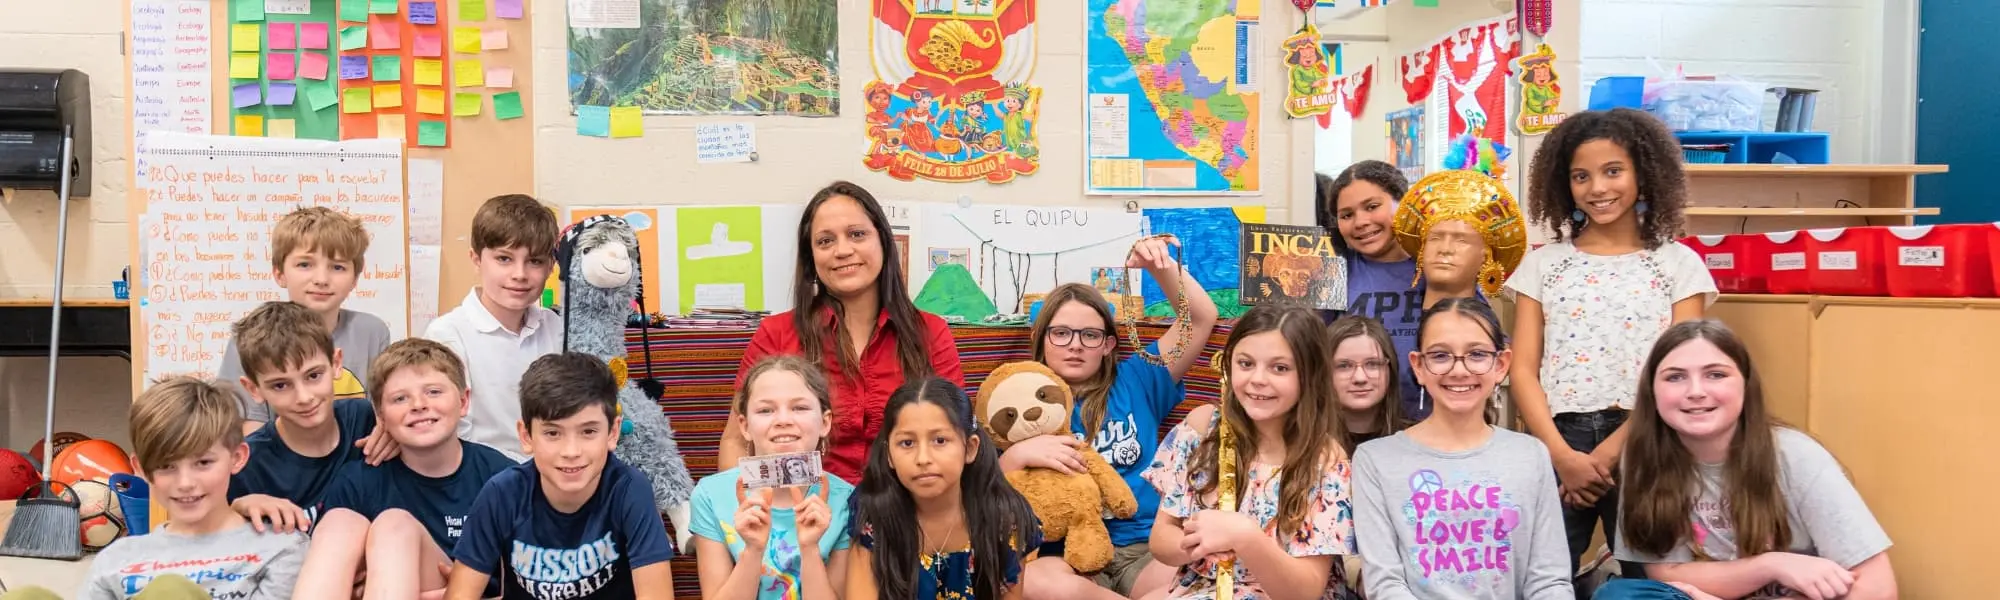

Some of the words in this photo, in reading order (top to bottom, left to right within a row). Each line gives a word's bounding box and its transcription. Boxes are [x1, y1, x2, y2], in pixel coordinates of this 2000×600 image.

[1294, 97, 1309, 109] TE
[1311, 92, 1336, 107] AMO
[1526, 115, 1539, 126] TE
[203, 165, 246, 187] puedes
[252, 165, 289, 184] hacer
[298, 172, 319, 192] para
[903, 157, 933, 175] FELIZ
[935, 166, 947, 177] 28
[949, 166, 965, 177] DE
[967, 159, 997, 177] JULIO
[211, 185, 240, 203] hacer
[994, 209, 1013, 225] EL
[1026, 209, 1088, 227] QUIPU
[1249, 231, 1337, 259] INCA
[1410, 484, 1503, 520] PEACE
[1415, 519, 1487, 545] LOVE
[1418, 546, 1512, 579] SMILE
